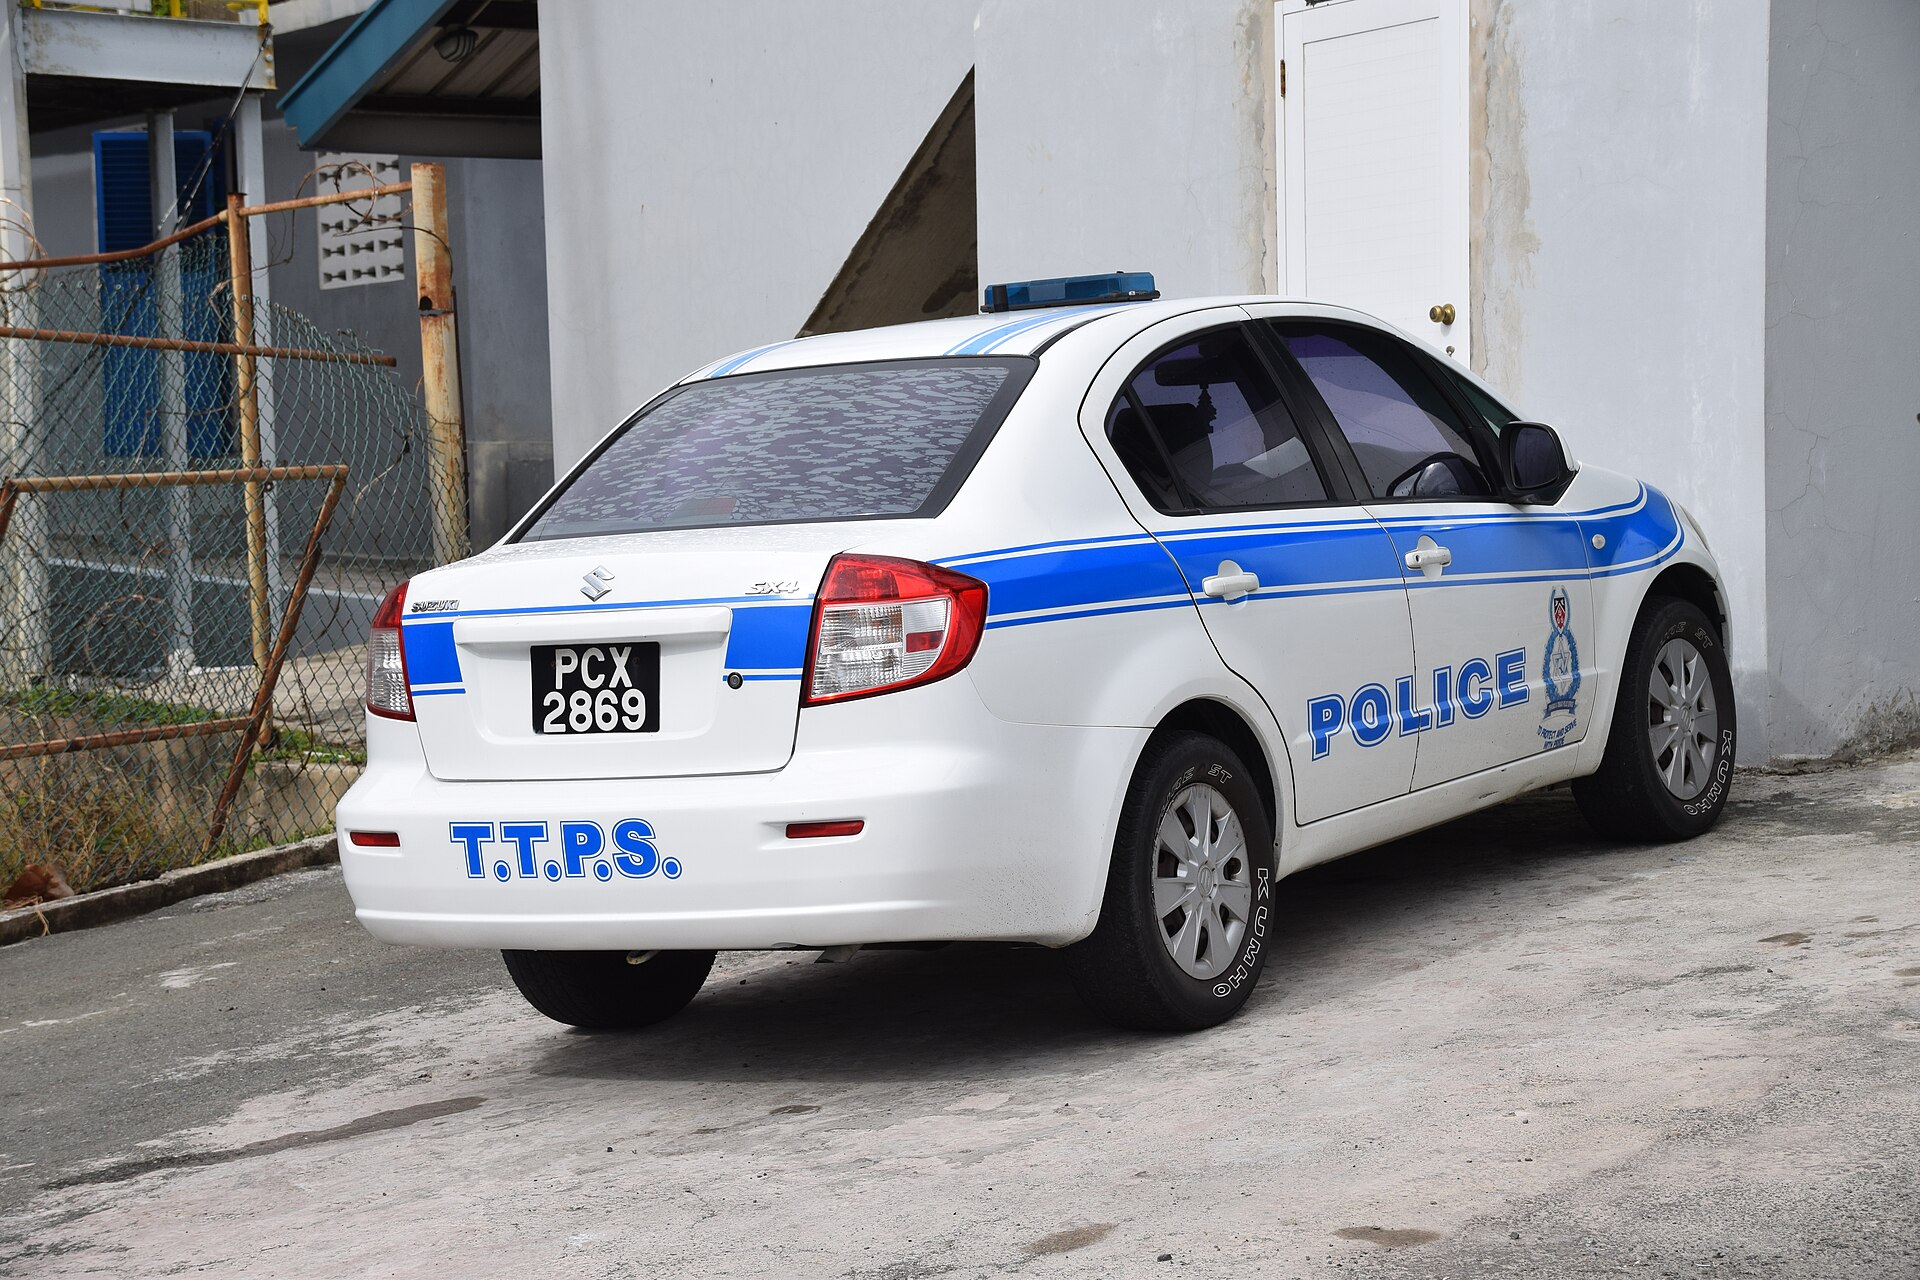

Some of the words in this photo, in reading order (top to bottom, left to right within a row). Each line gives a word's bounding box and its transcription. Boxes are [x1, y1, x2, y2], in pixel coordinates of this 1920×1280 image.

[411, 599, 460, 613] SUZUKI
[744, 580, 800, 595] SX4
[1694, 627, 1714, 649] ST
[555, 646, 633, 690] PCX
[543, 688, 646, 733] 2869
[1307, 646, 1530, 761] POLICE
[1207, 763, 1233, 785] ST
[1684, 729, 1732, 817] KUMHO
[448, 818, 683, 882] T.T.P.S.
[1213, 868, 1269, 998] KUMHO
